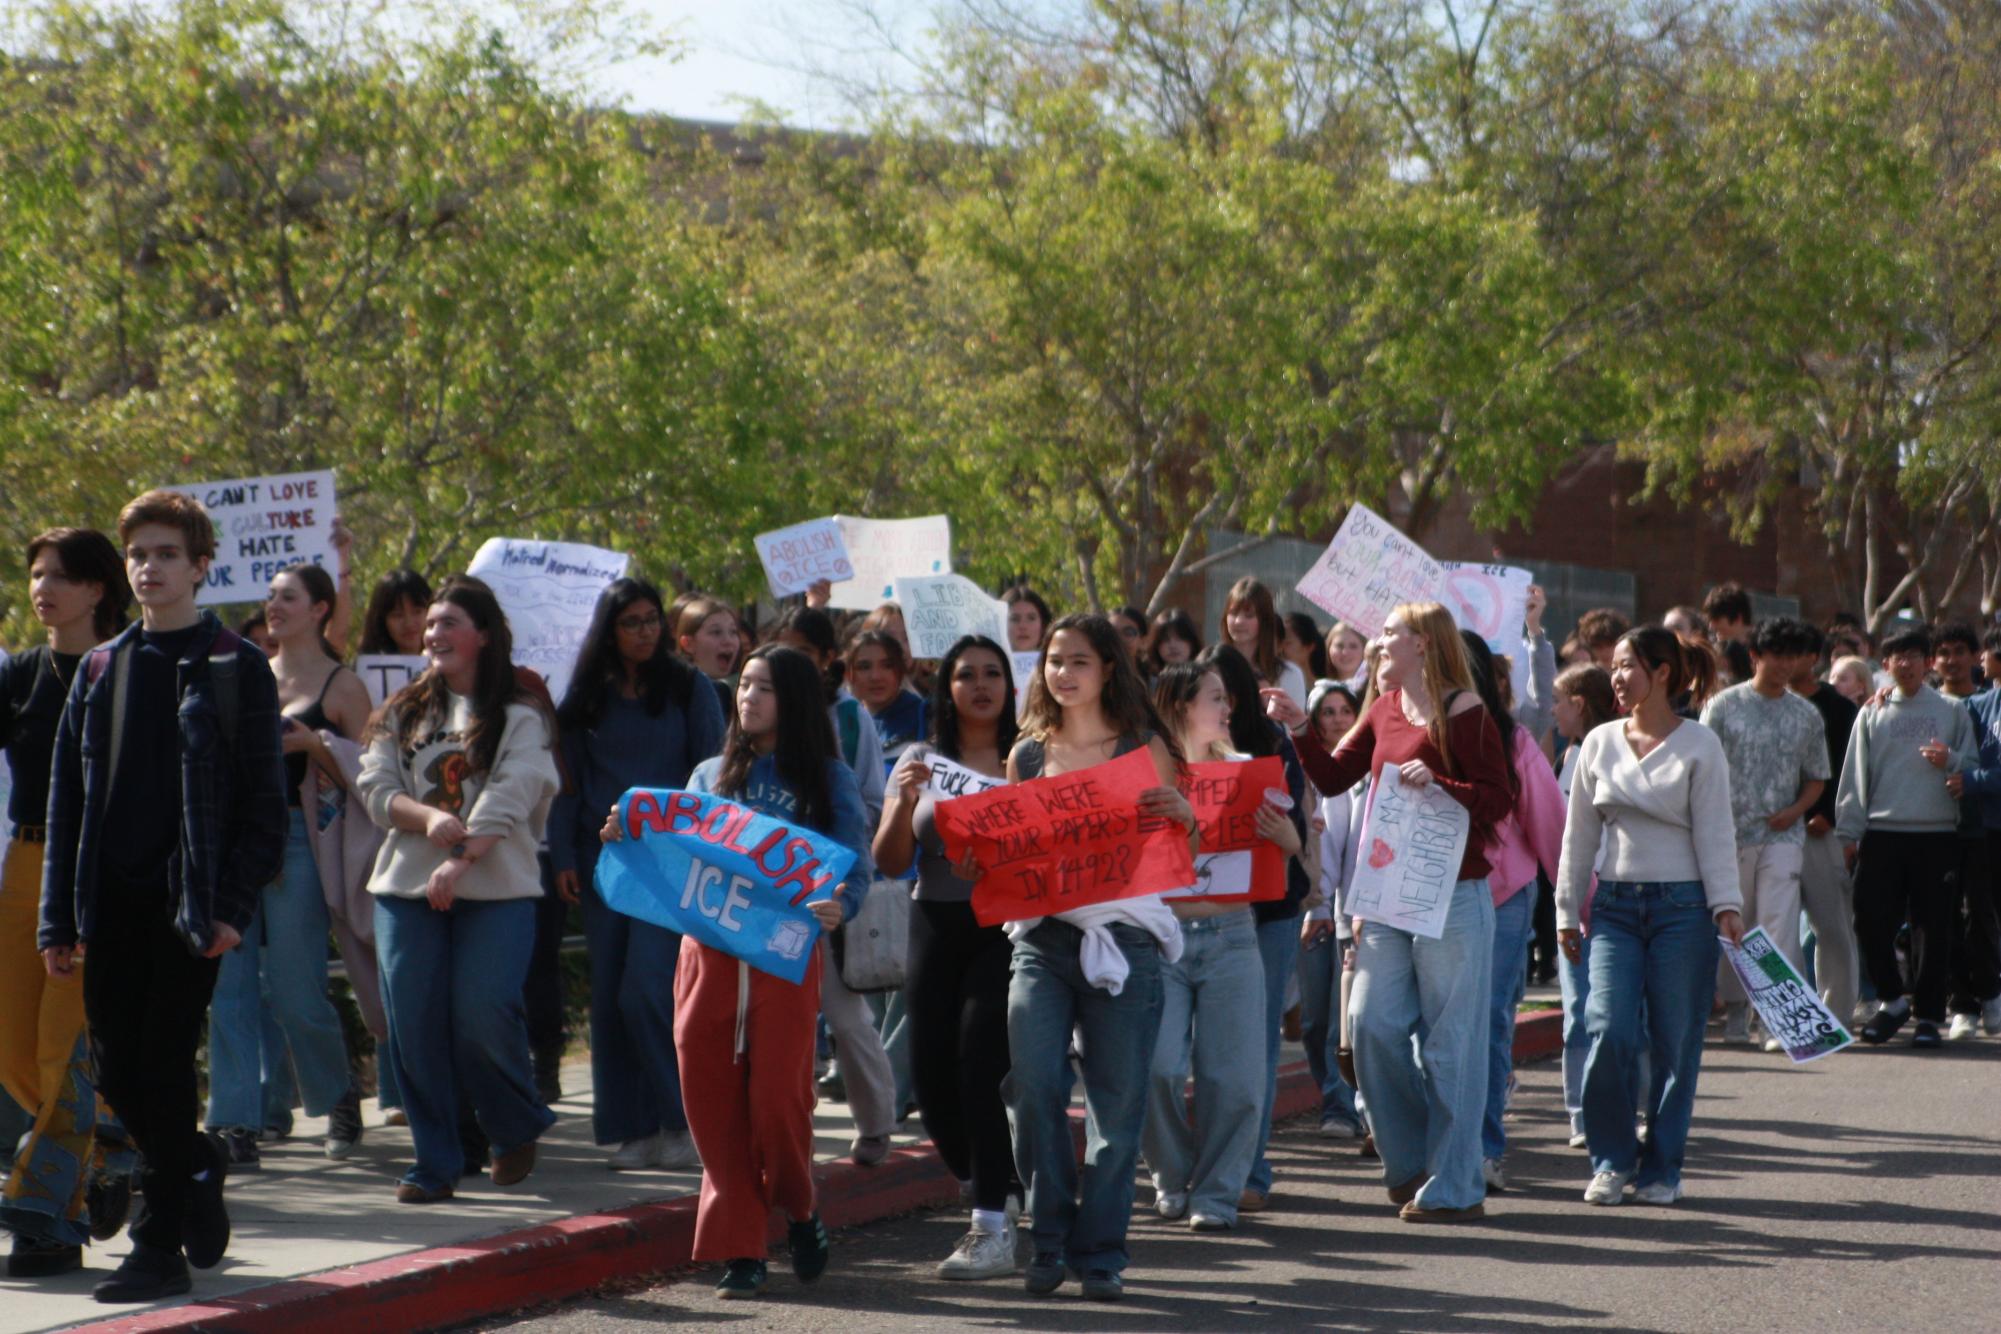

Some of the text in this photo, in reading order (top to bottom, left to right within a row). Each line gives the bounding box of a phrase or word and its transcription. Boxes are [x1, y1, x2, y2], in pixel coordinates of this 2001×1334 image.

[205, 480, 318, 509] CAN'T LOVE
[239, 535, 296, 557] HATE
[770, 531, 835, 565] ABOLISH
[207, 565, 235, 588] UR
[787, 556, 833, 579] ICE
[1366, 579, 1402, 609] HAT
[911, 609, 959, 631] AND
[956, 780, 1104, 837] WHERE WERE
[626, 790, 834, 907] ABOLISH
[993, 810, 1130, 860] YOUR PAPERS
[1014, 845, 1131, 902] IN 1492?
[679, 857, 754, 933] ICE
